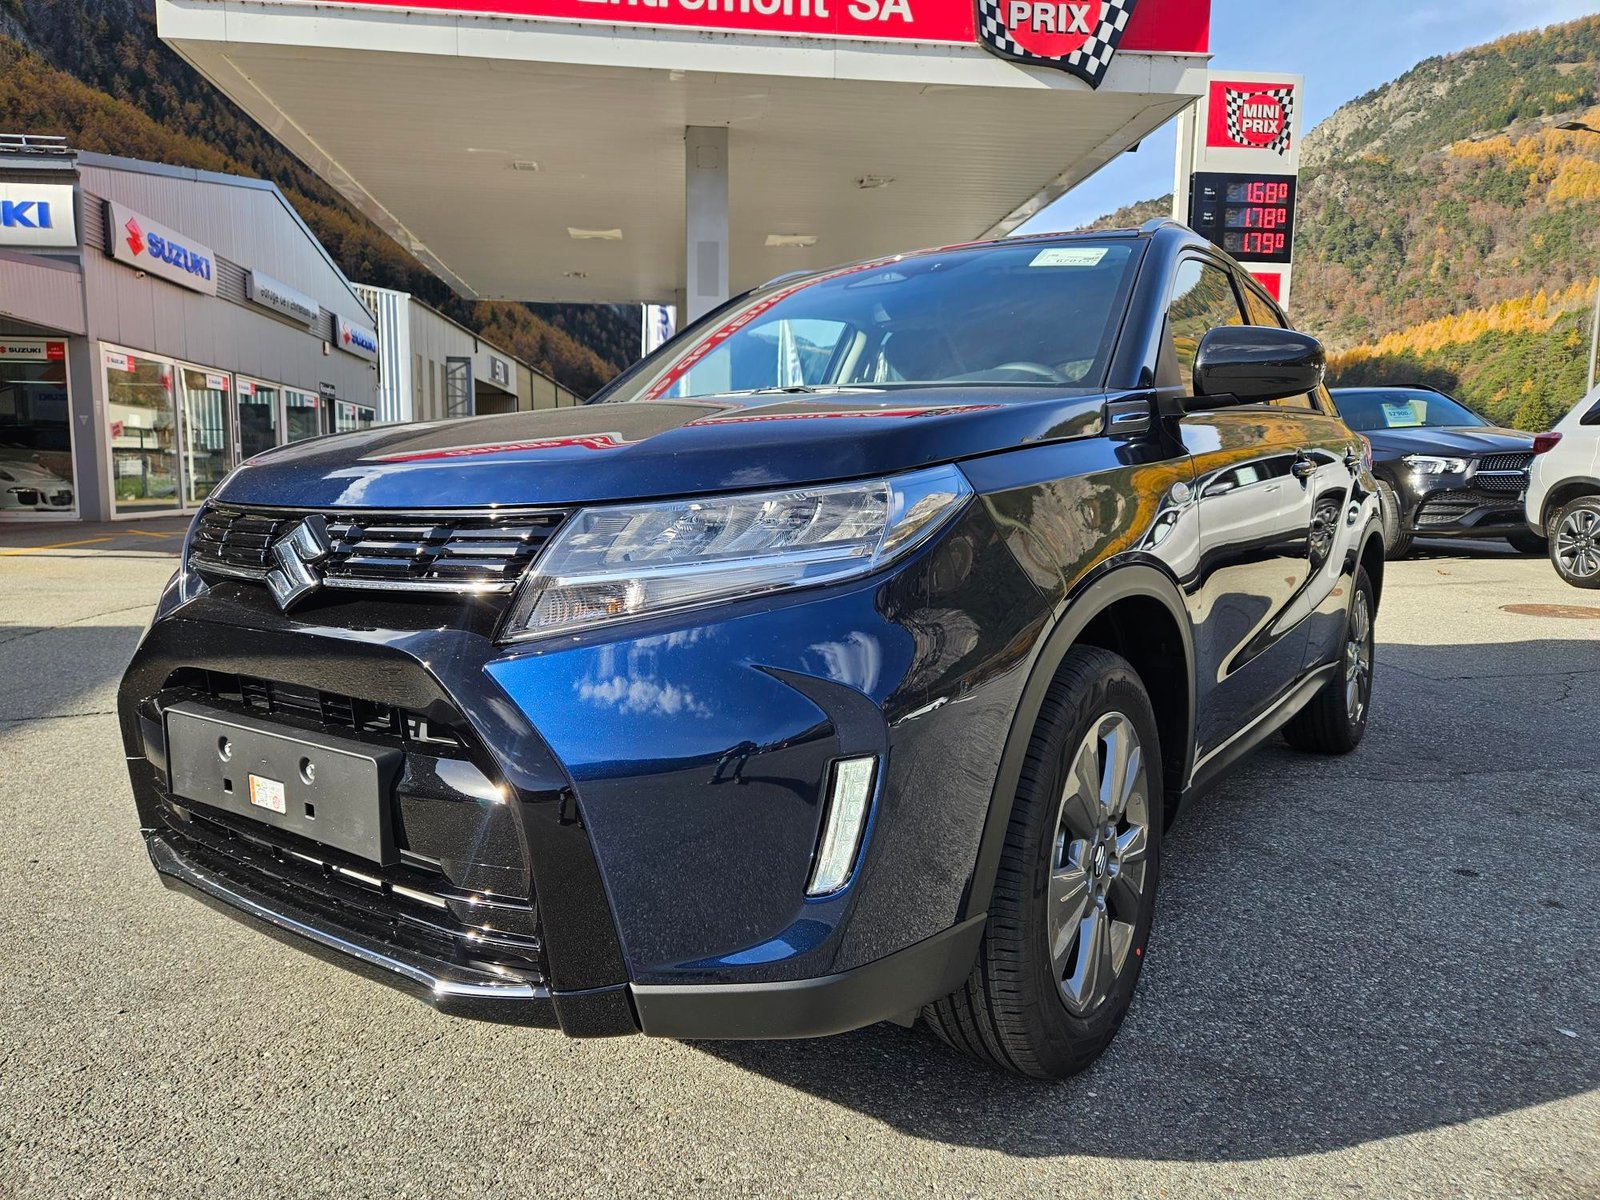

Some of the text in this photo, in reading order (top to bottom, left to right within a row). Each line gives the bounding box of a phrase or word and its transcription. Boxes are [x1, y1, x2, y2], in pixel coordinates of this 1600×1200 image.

[847, 0, 914, 22] SA
[1009, 1, 1091, 35] PRIX
[1242, 104, 1280, 120] MINI
[1241, 118, 1279, 134] PRIX
[0, 200, 52, 228] KI
[147, 232, 211, 280] SUZUKI
[351, 329, 376, 353] SUZUKI
